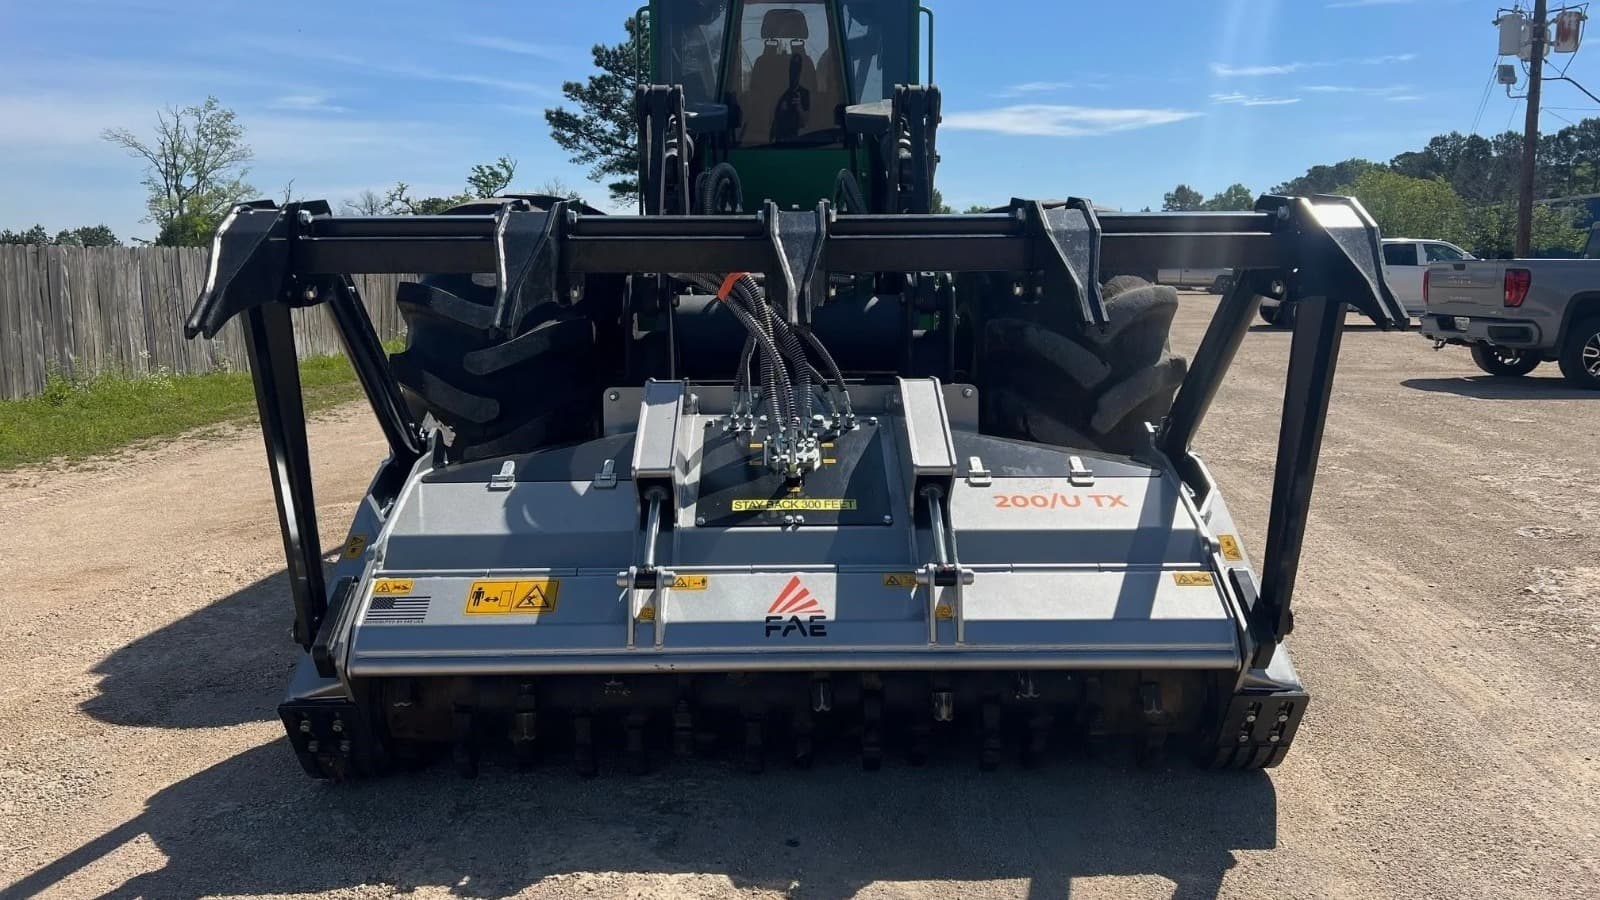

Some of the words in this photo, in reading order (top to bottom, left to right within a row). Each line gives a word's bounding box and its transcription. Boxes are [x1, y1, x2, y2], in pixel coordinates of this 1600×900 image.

[734, 500, 763, 509] STAY
[766, 500, 798, 509] BACK
[801, 500, 820, 509] 300
[824, 500, 854, 509] FEET
[993, 493, 1081, 509] 200/U
[1088, 495, 1129, 507] TX
[765, 615, 827, 637] FAE
